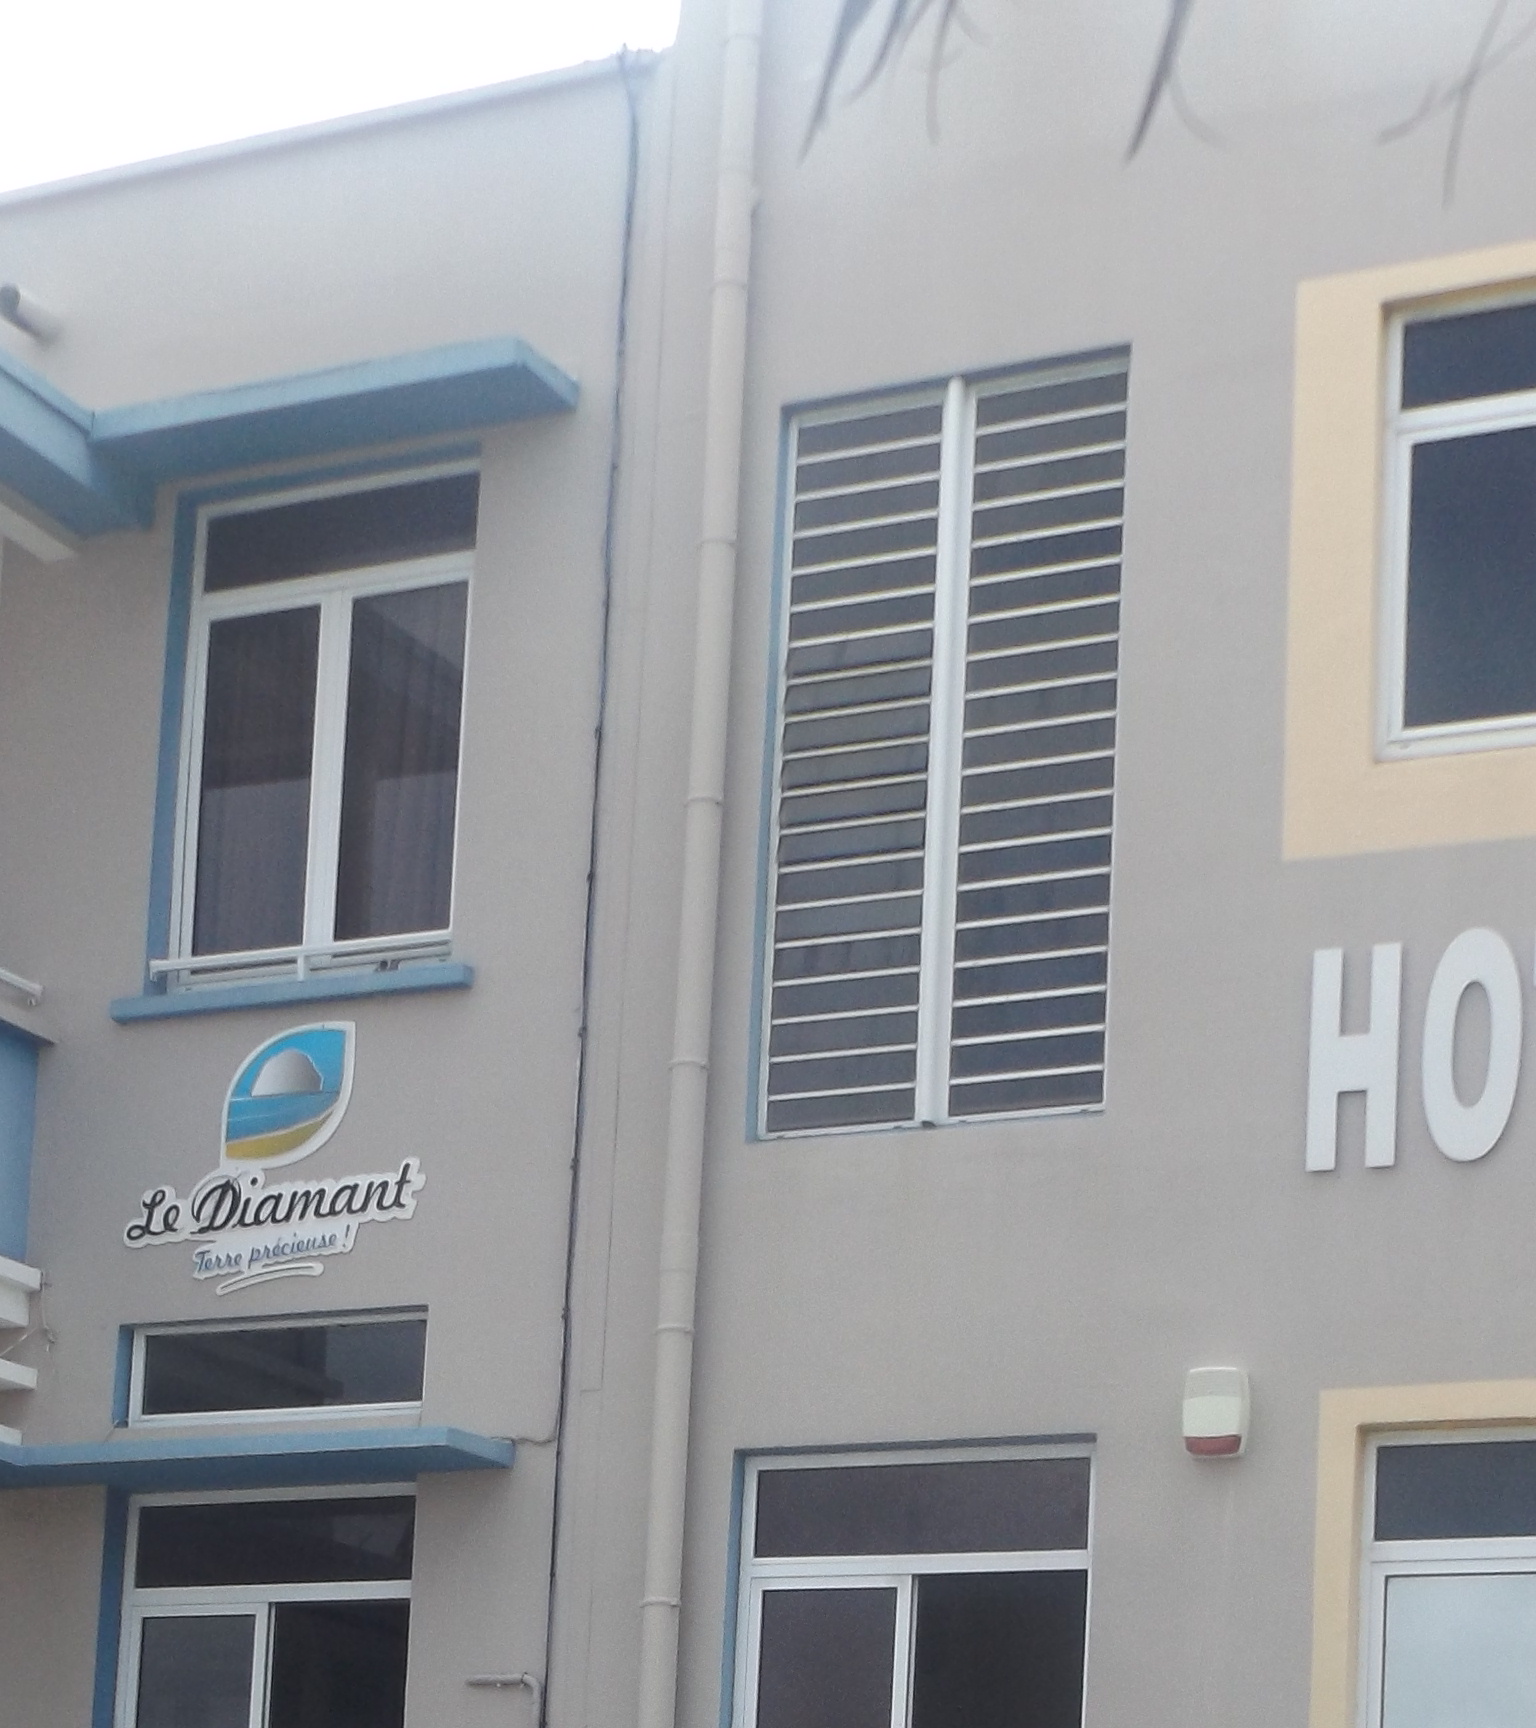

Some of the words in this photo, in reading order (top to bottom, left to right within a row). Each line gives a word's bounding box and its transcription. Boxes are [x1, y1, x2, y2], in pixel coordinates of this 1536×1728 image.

[126, 1188, 181, 1240] Le
[190, 1161, 413, 1235] Diamant
[195, 1249, 243, 1272] Terre
[248, 1231, 338, 1267] précieuse
